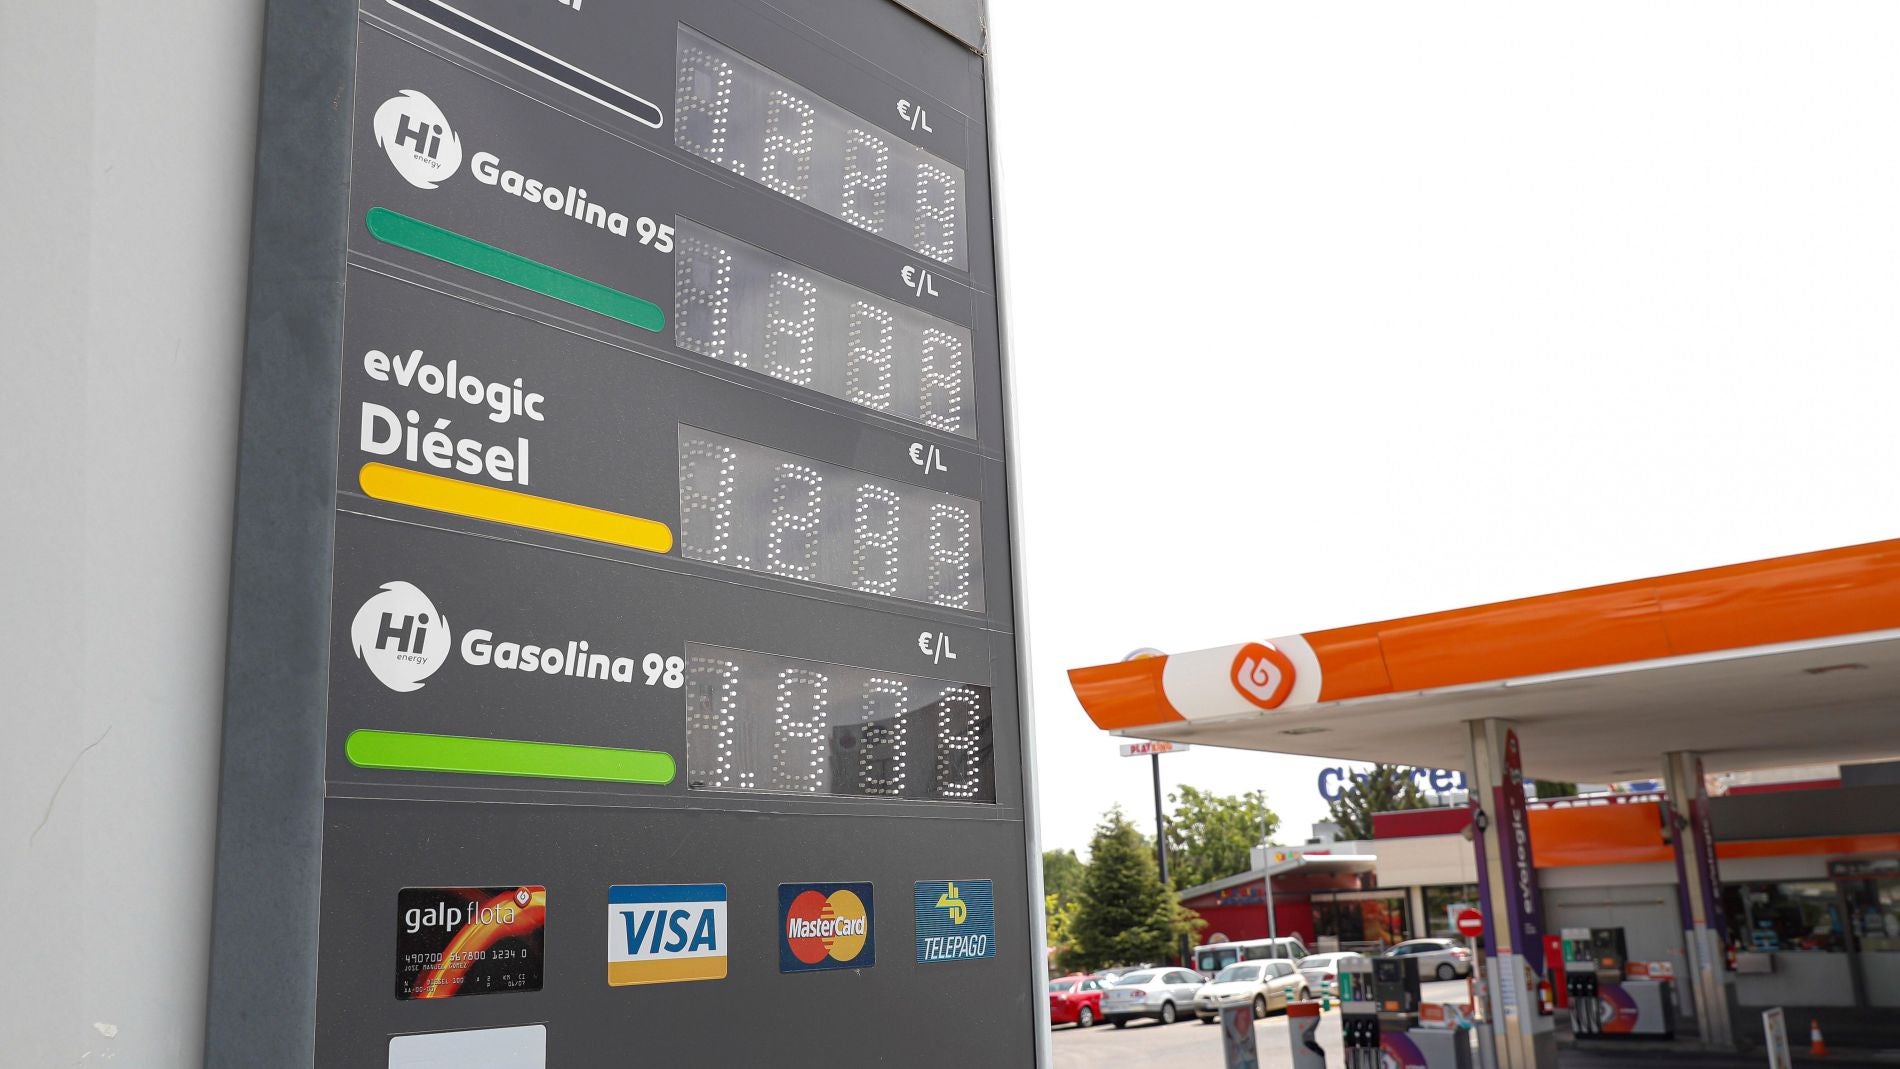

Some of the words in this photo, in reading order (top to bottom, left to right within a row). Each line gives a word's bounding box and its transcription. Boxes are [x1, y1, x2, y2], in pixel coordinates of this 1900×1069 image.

[896, 99, 933, 133] €/L
[394, 113, 443, 160] Hi
[413, 153, 442, 169] energy
[471, 151, 629, 237] Gasolina
[636, 216, 675, 254] 95
[900, 265, 939, 297] €/L
[363, 349, 545, 423] evologic
[360, 401, 529, 486] Diésel
[908, 442, 948, 475] €/L
[375, 612, 430, 655] Hi
[917, 631, 957, 665] €/L
[396, 653, 428, 665] energy
[460, 628, 635, 683] Gasolina
[642, 652, 685, 689] 98
[405, 901, 462, 934] galp
[466, 901, 516, 926] flota
[619, 909, 716, 955] VISA
[788, 915, 866, 939] MasterCard
[405, 952, 443, 963] 490700
[492, 949, 516, 960] 1234
[924, 934, 987, 960] TELEPAGO
